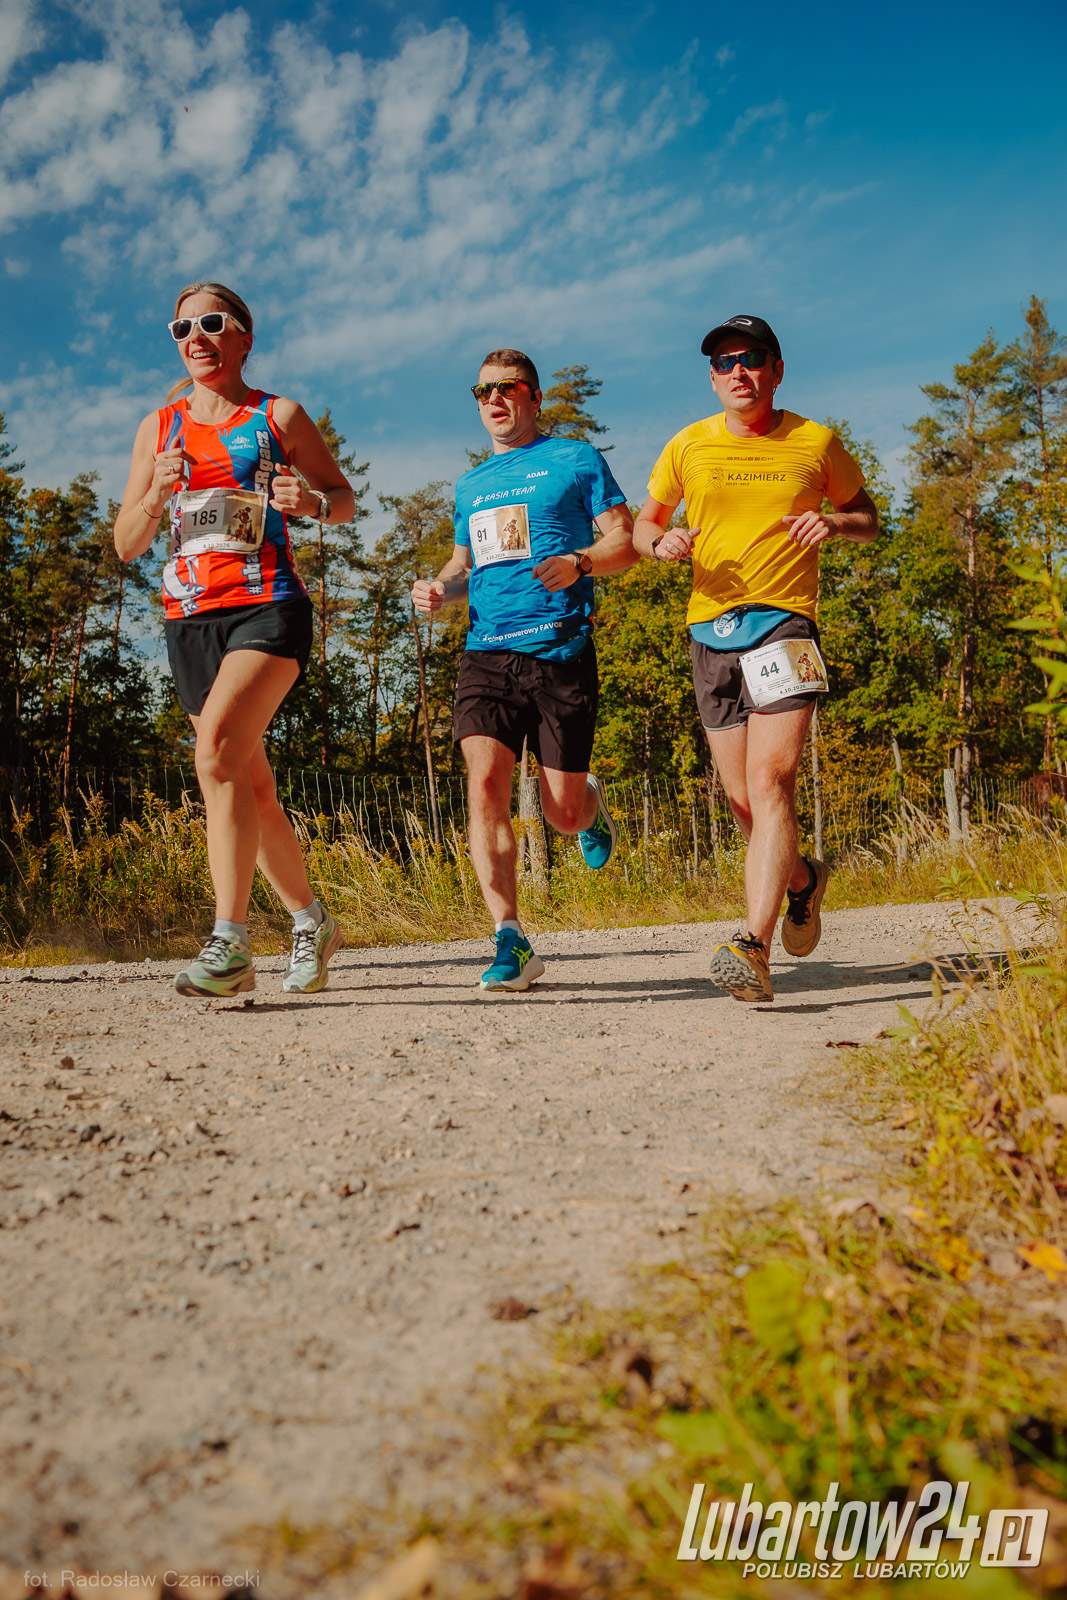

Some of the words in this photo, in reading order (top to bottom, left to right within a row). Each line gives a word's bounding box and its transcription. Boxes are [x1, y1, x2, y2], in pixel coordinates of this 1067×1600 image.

[526, 470, 548, 480] ADAM
[727, 473, 786, 482] KAZIMIERZ
[511, 485, 536, 498] TEAM
[191, 509, 217, 526] 185
[477, 528, 487, 543] 91
[504, 627, 539, 640] rowerowy
[760, 661, 780, 678] 44
